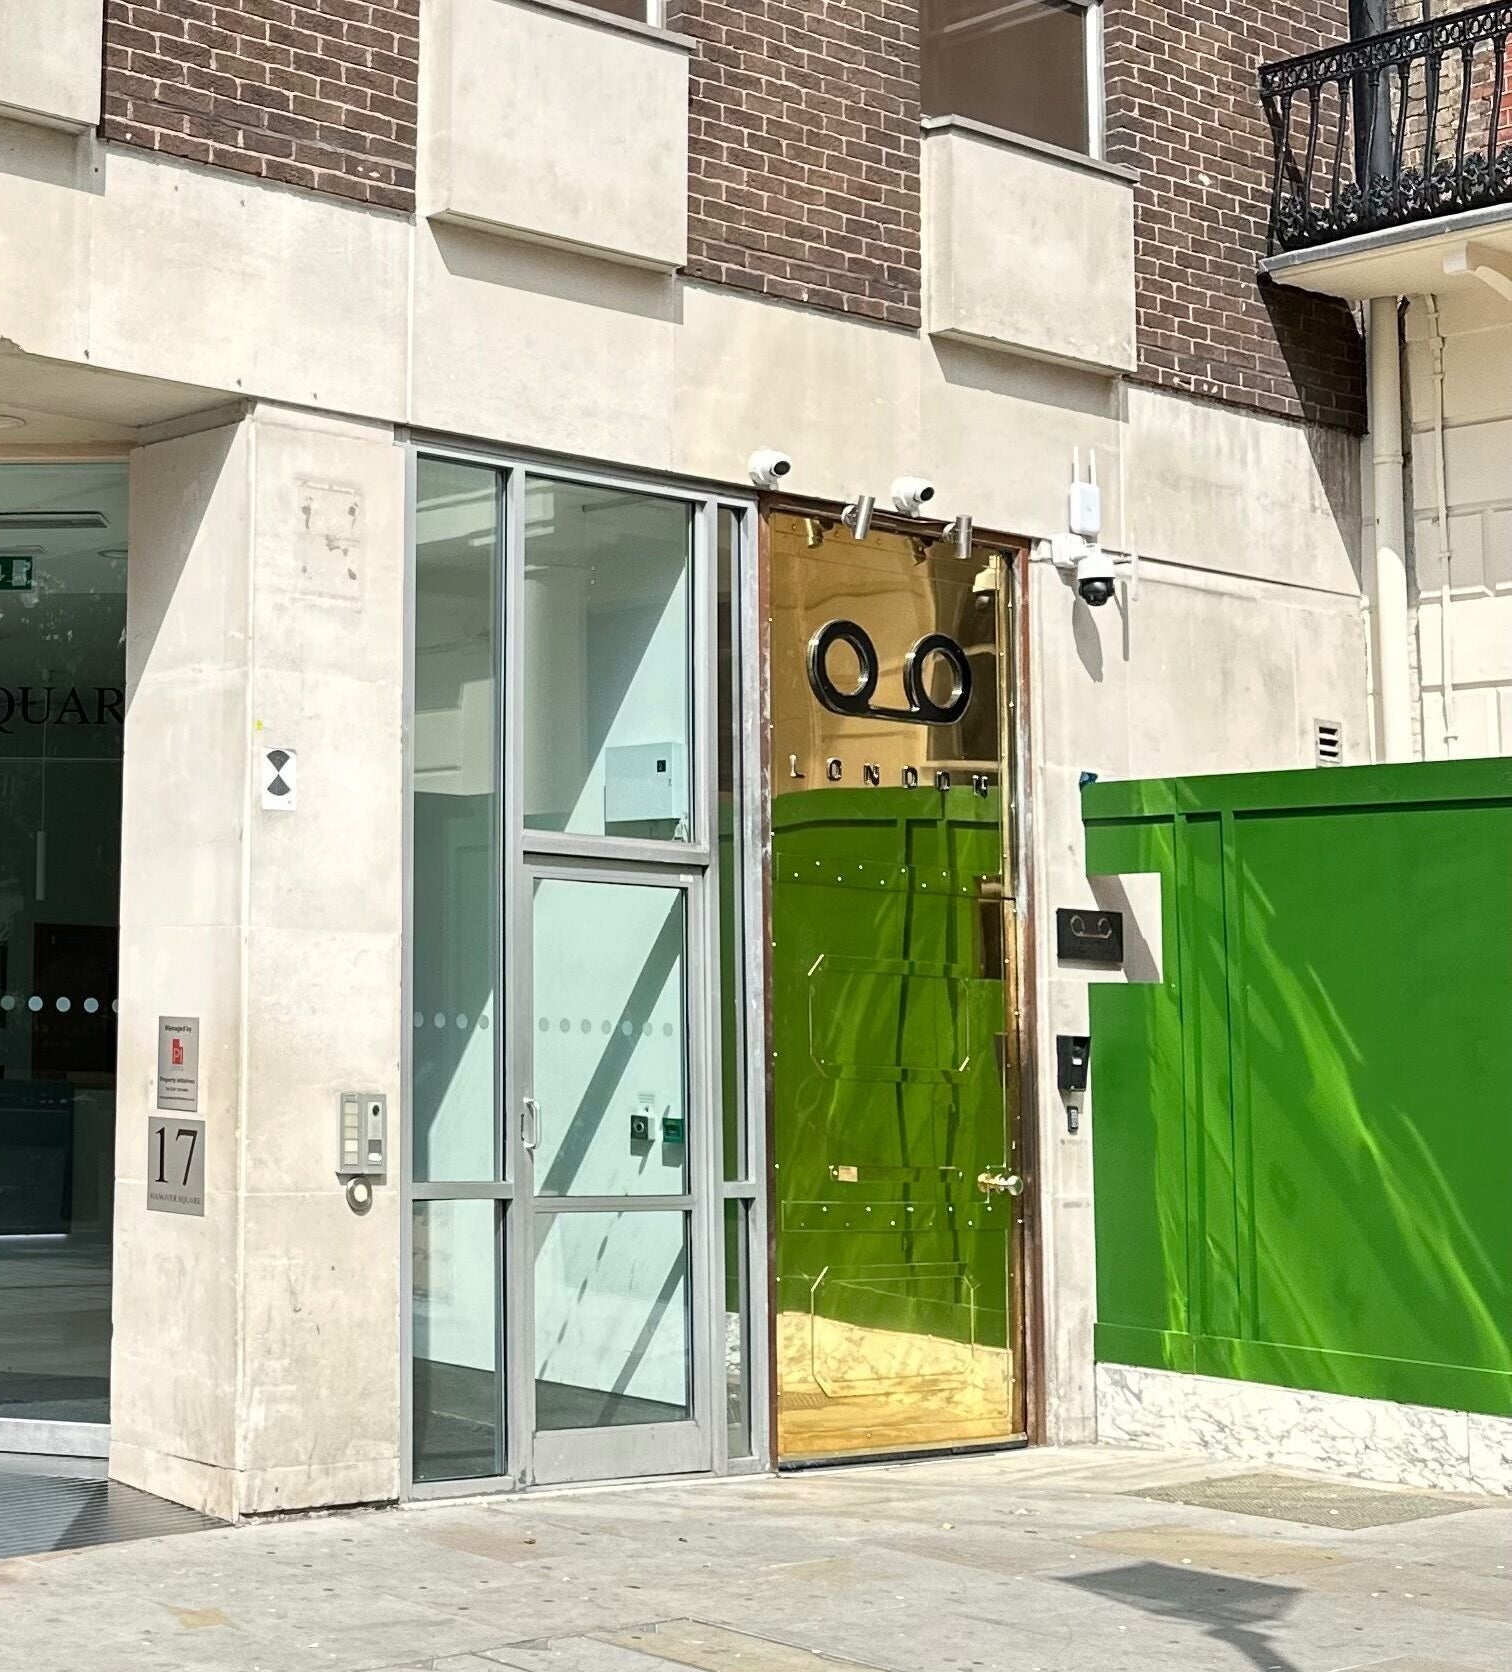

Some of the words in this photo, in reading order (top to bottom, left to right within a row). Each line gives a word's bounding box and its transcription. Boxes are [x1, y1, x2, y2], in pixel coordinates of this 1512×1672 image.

[789, 754, 988, 798] LONDON
[155, 1126, 198, 1186] 17
[150, 1192, 177, 1203] HANOVER
[176, 1195, 200, 1206] SQUARE
